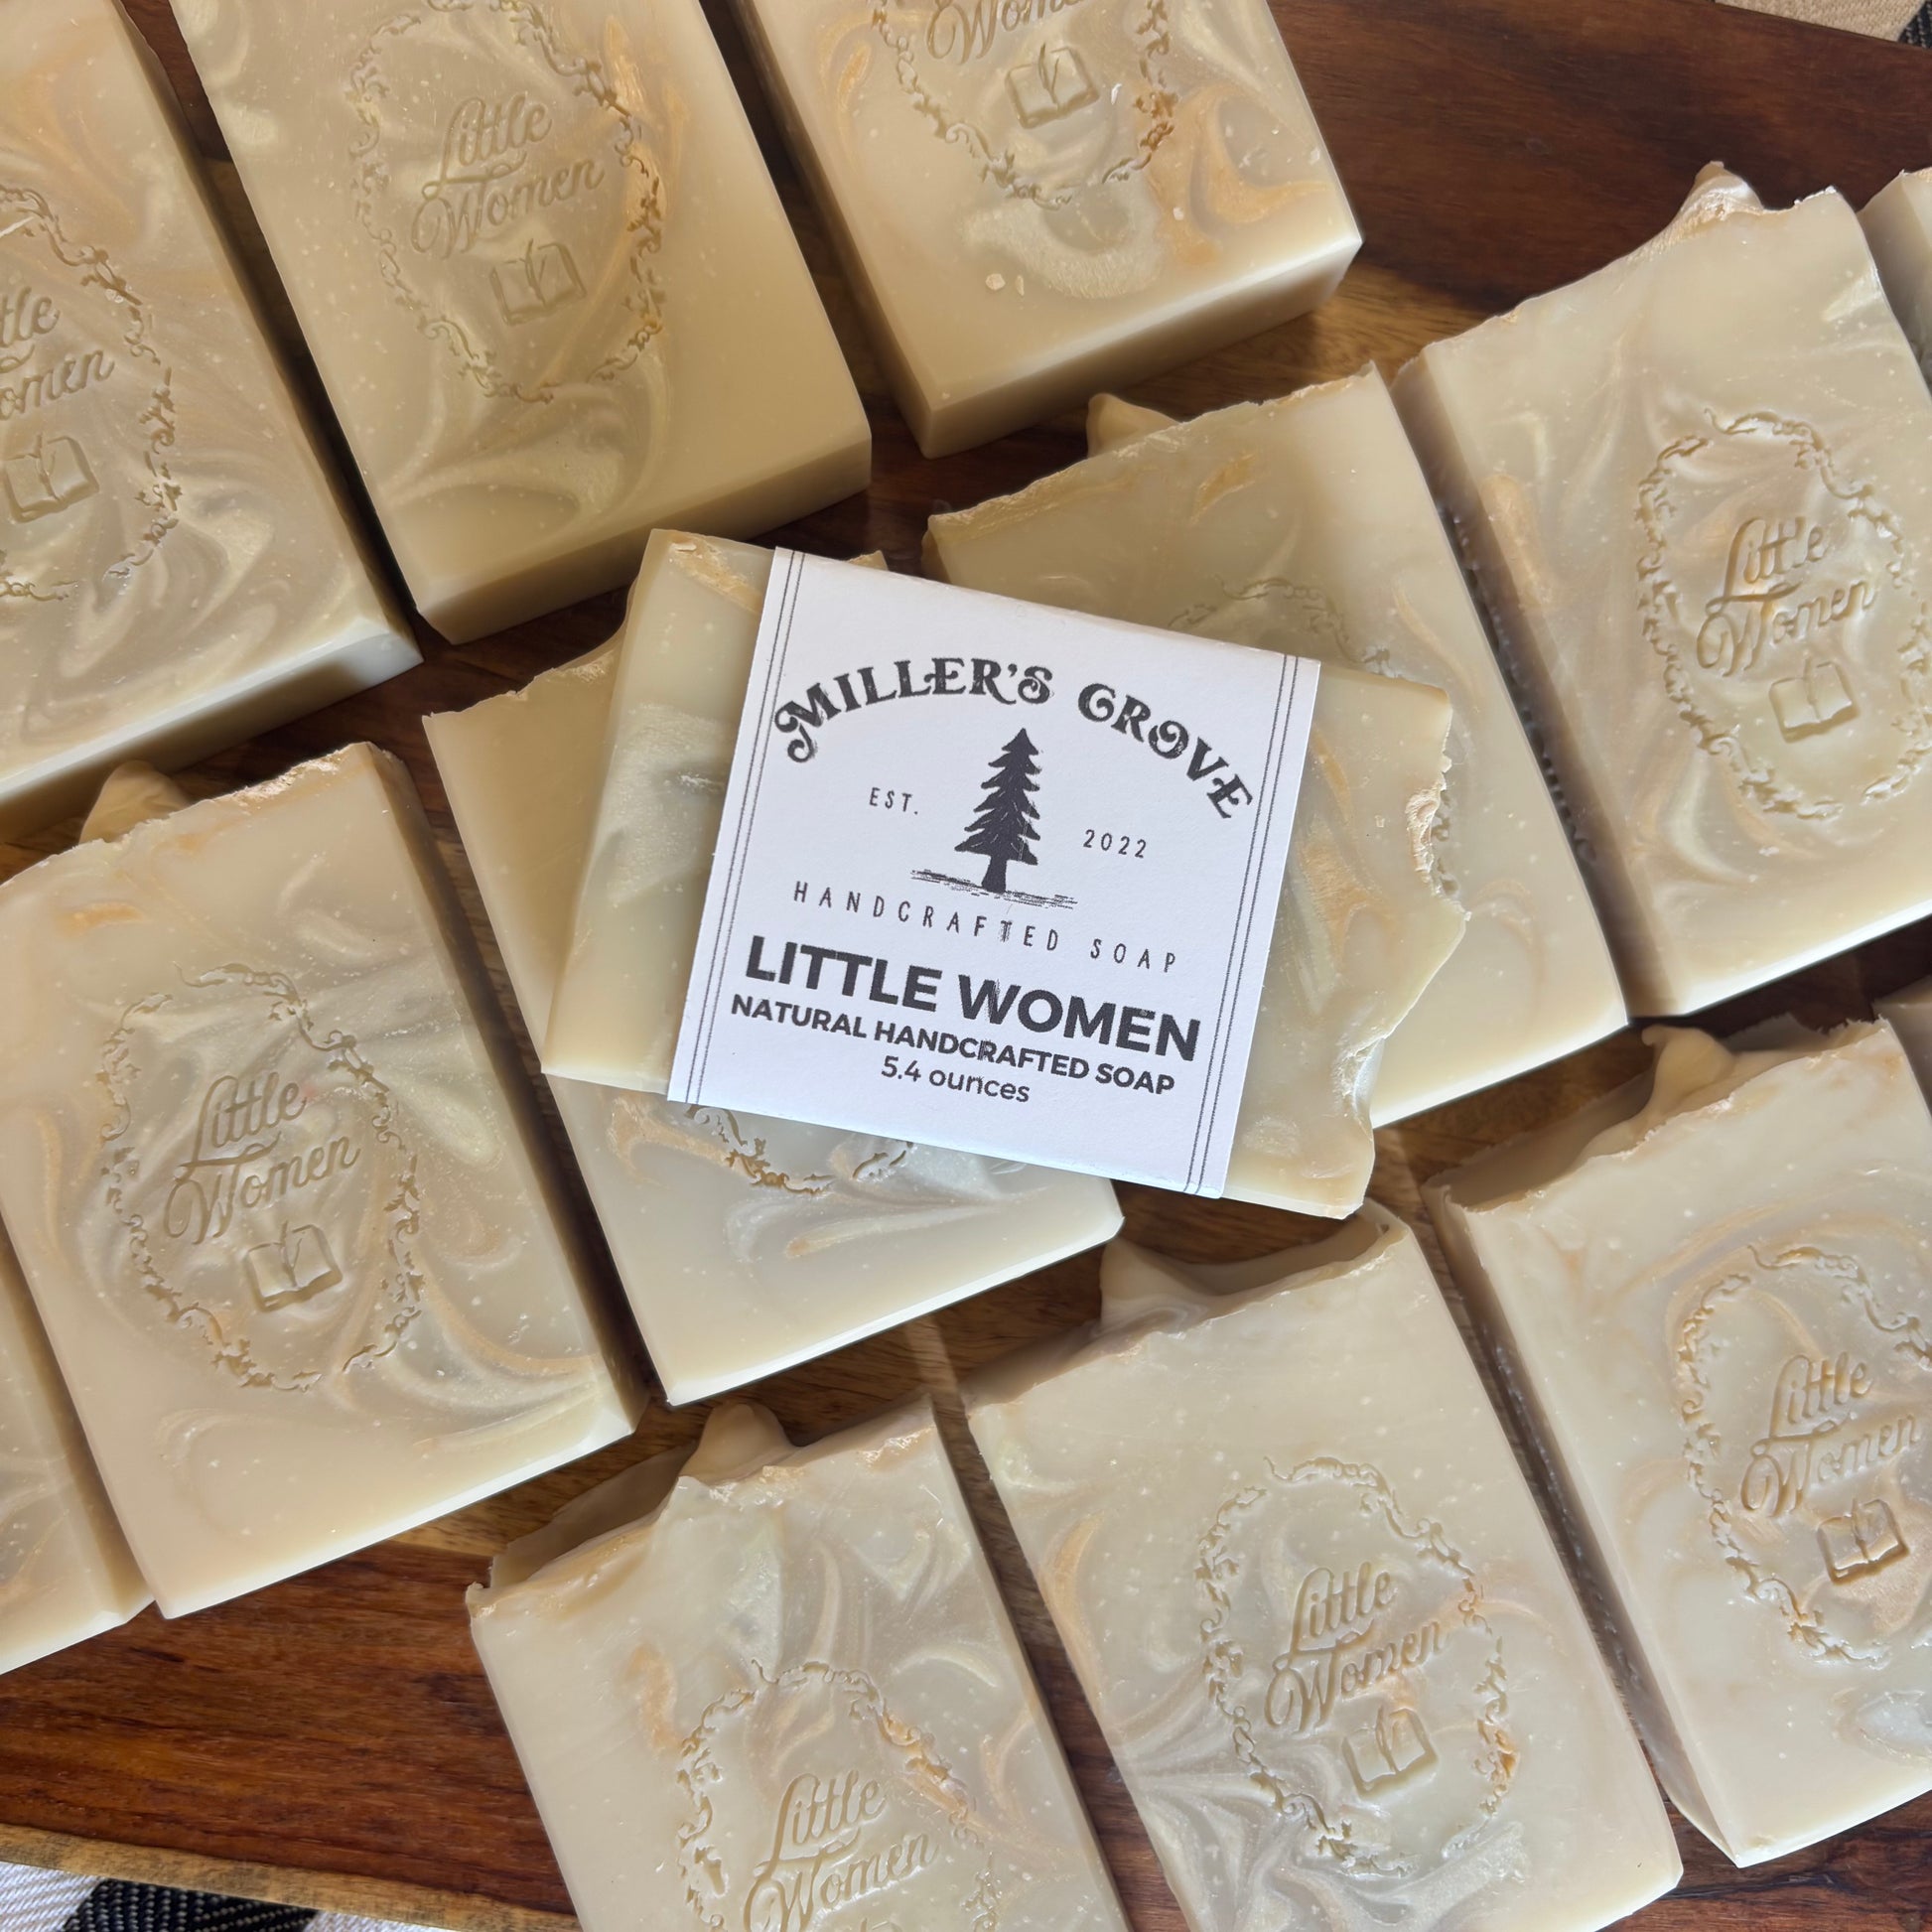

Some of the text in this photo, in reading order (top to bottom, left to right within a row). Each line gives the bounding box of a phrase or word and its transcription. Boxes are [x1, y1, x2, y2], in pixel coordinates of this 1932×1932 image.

[421, 92, 553, 199] Little
[410, 158, 605, 260] Women
[0, 349, 115, 421] omen
[1707, 515, 1829, 617] Little
[1696, 578, 1878, 677] Women
[773, 657, 1254, 819] MILLER'S GROVE
[869, 786, 920, 816] EST.
[1082, 829, 1148, 860] 2022
[793, 881, 1177, 974] HANDCRAFTED SOAP
[731, 993, 1175, 1095] NATURAL HANDCRAFTED SOAP
[745, 934, 1201, 1062] LITTLE WOMEN
[173, 1070, 308, 1180] Little
[881, 1054, 1032, 1104] 5.4 ounces
[163, 1136, 361, 1245] Women
[1750, 1350, 1875, 1460] Little
[1740, 1412, 1920, 1518] Women
[1272, 1561, 1397, 1676] Little
[1264, 1620, 1448, 1733] Women
[752, 1769, 889, 1880] Little
[743, 1833, 940, 1932] Women
